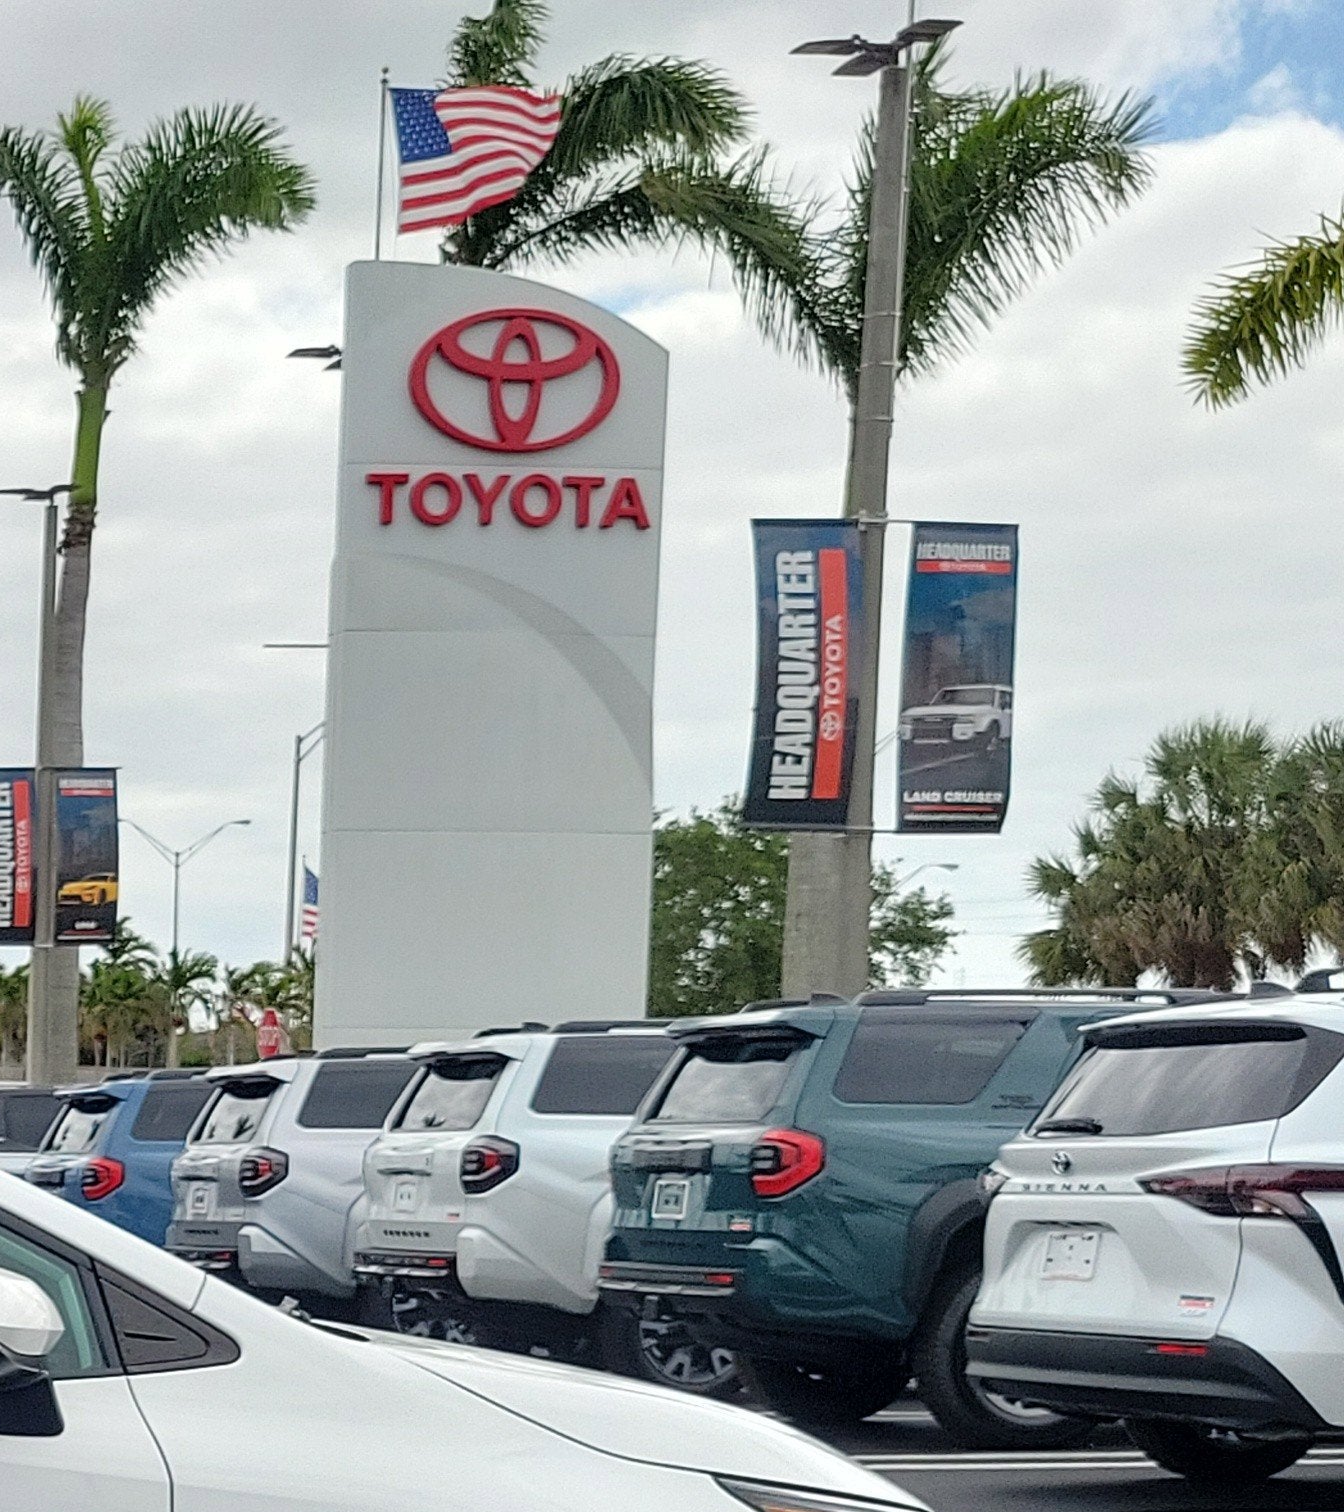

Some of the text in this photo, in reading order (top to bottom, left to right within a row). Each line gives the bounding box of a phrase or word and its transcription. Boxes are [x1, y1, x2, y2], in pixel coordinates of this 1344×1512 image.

[366, 472, 651, 529] TOYOTA
[767, 550, 820, 800] HEADQUARTER
[823, 614, 844, 708] TOYOTA
